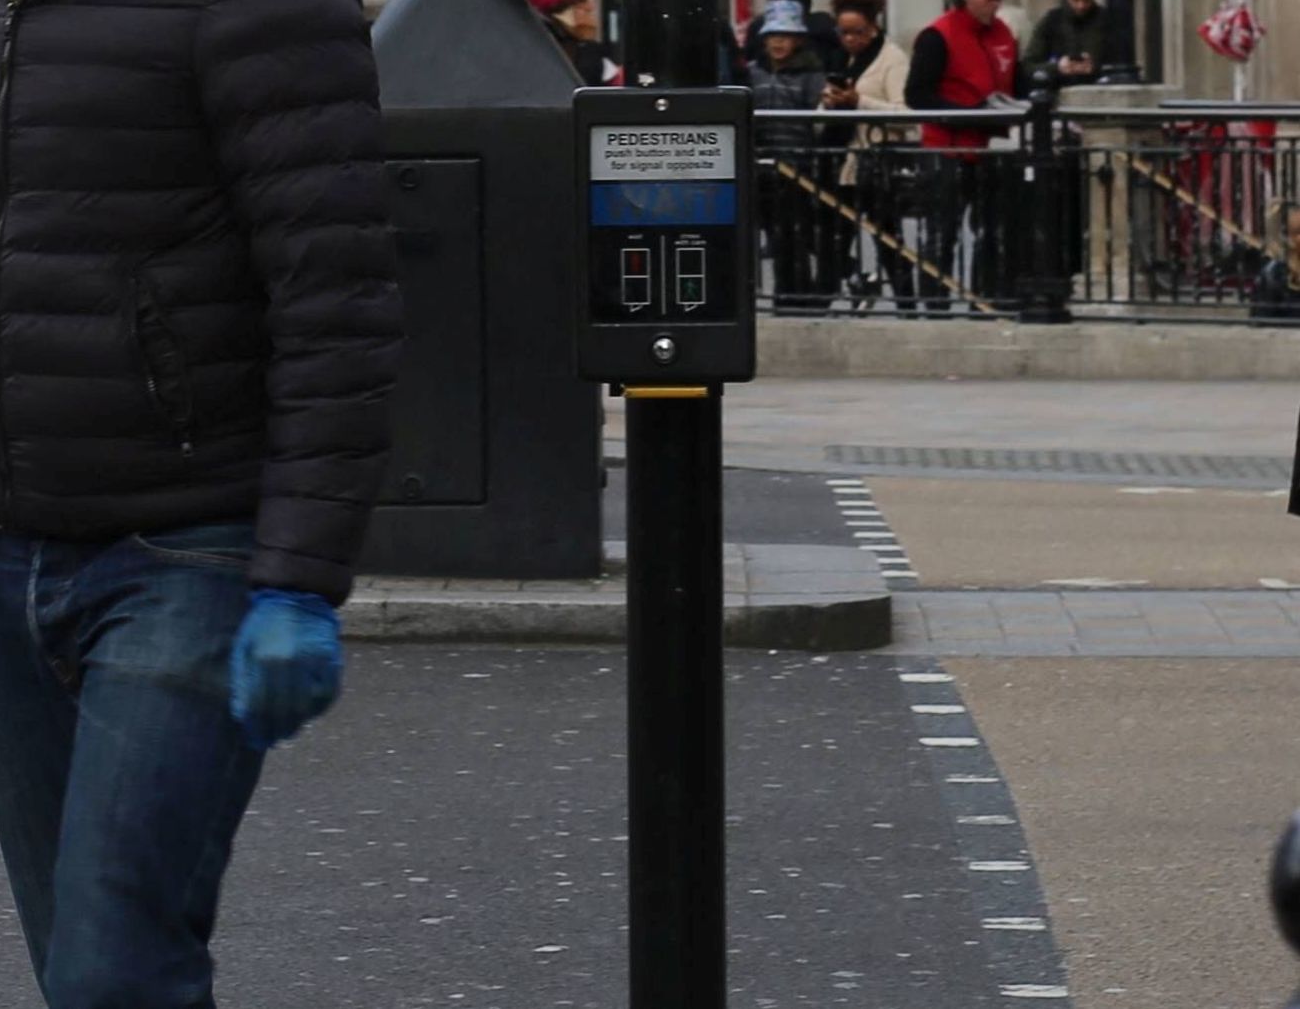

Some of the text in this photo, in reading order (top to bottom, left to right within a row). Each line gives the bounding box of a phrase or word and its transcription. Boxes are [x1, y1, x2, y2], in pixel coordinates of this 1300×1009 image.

[607, 132, 718, 146] PEDESTRIANS
[605, 147, 721, 159] push button and wait
[611, 160, 714, 172] for signal opposite
